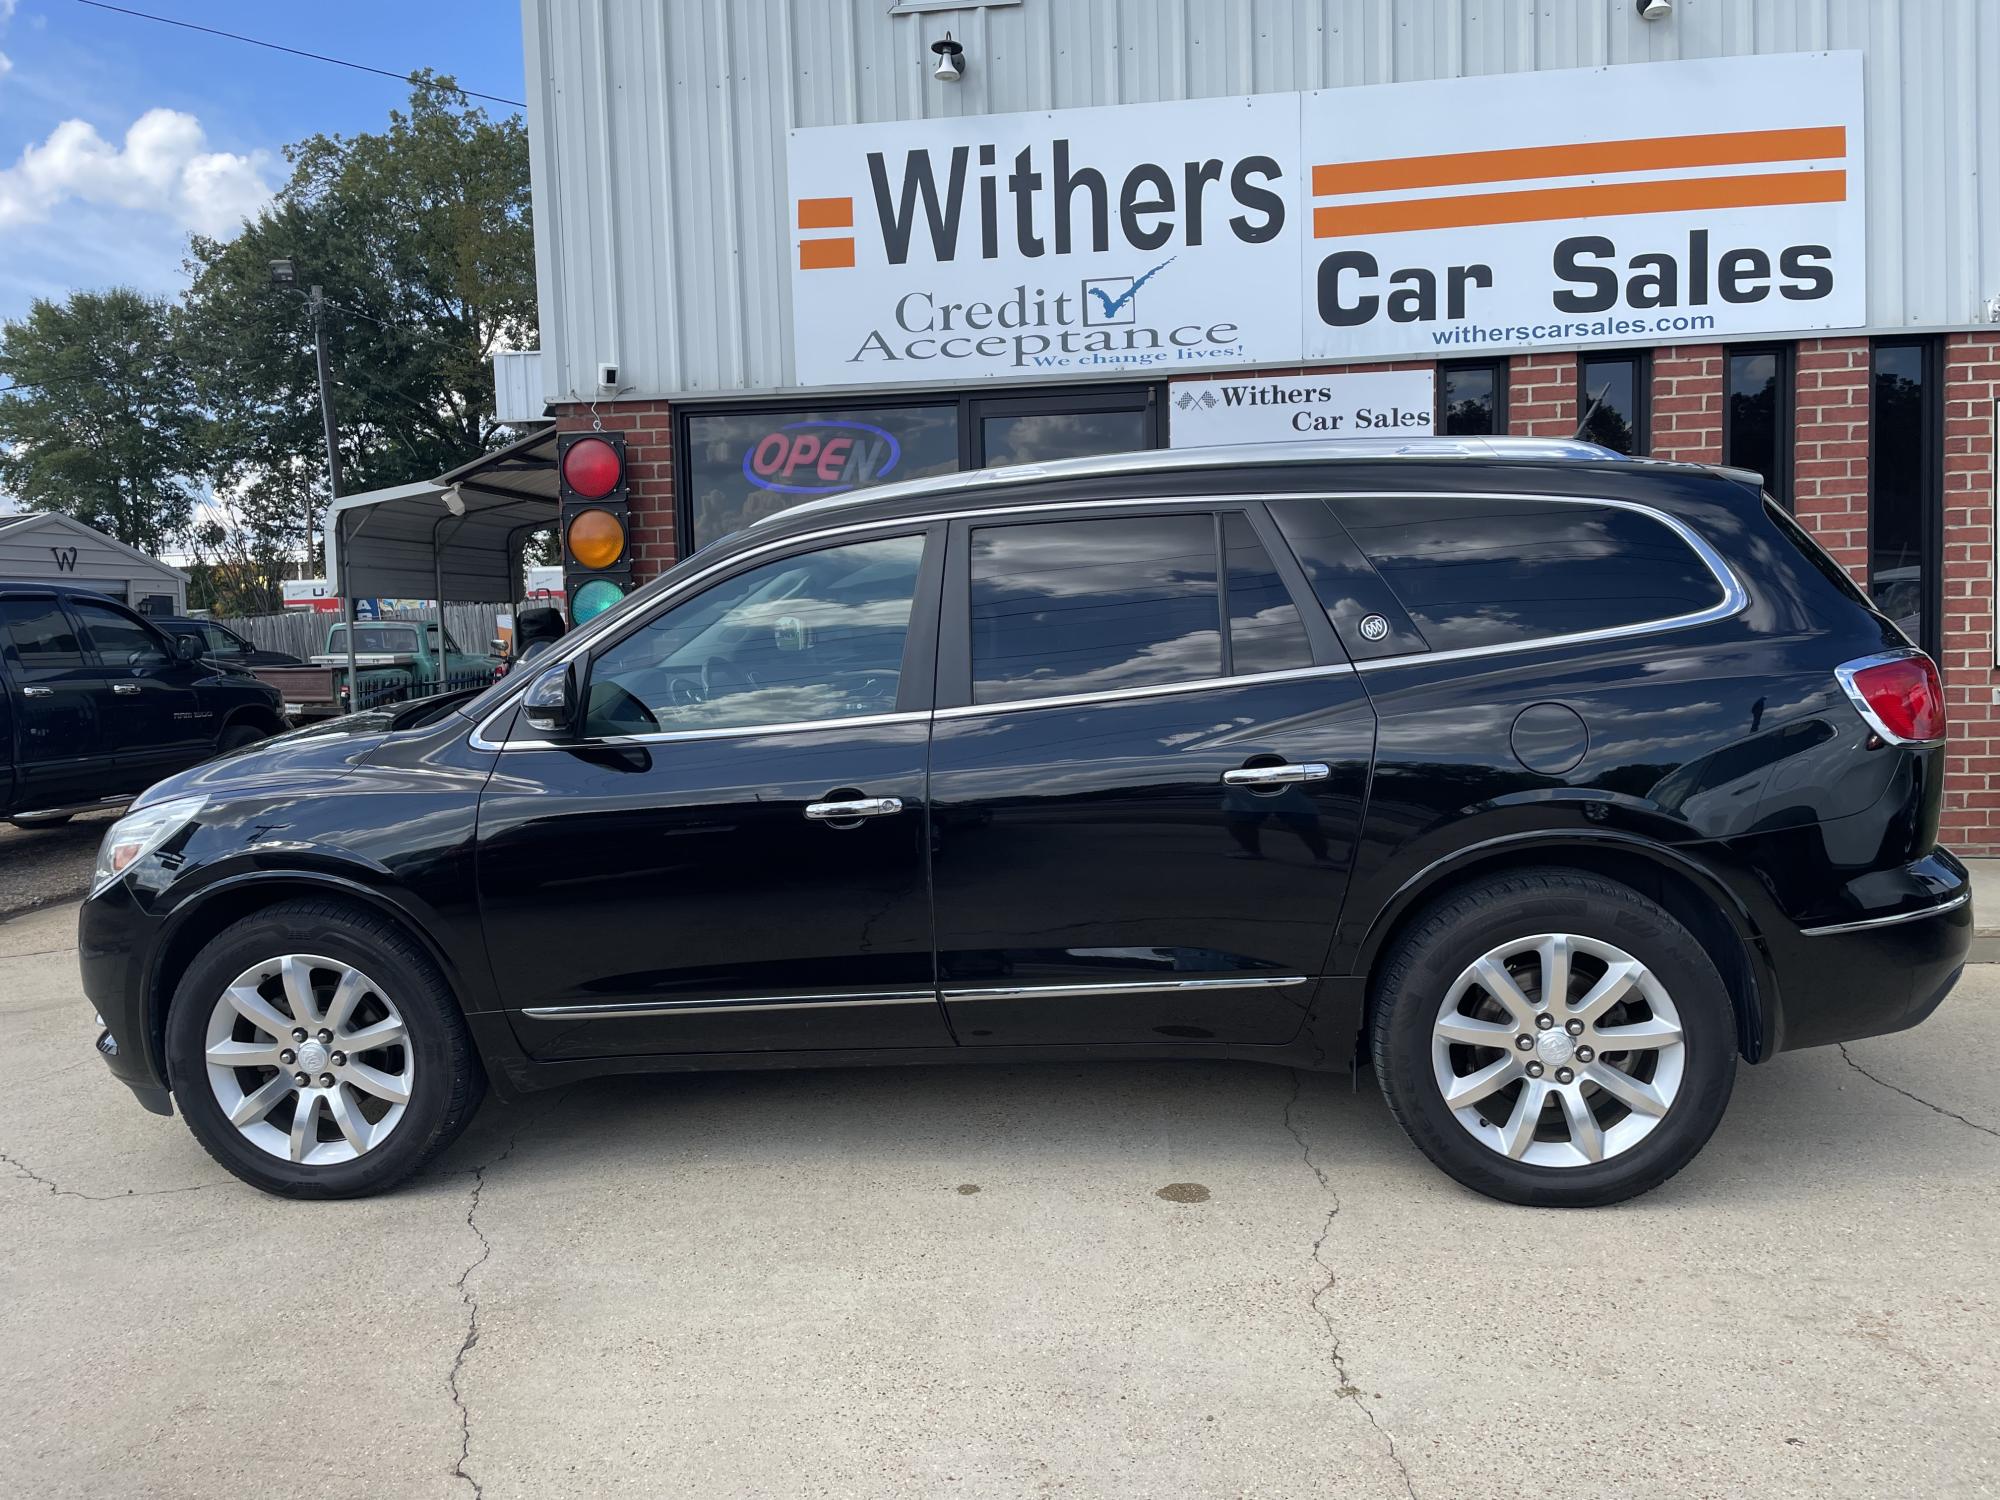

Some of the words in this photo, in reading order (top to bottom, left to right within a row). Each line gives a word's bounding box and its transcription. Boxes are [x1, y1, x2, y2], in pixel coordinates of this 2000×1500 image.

[866, 139, 1286, 265] Withers
[1317, 250, 1493, 327] Car
[1552, 229, 1834, 314] Sales
[895, 284, 1075, 333] Credit
[845, 323, 1239, 368] Acceptance
[1431, 315, 1715, 346] witherscarsales.com
[1032, 355, 1069, 367] We
[1079, 353, 1166, 365] change
[1177, 344, 1244, 360] lives!
[1220, 384, 1332, 407] Withers
[1291, 411, 1344, 432] Car
[1355, 407, 1431, 429] Sales
[753, 432, 884, 483] OPEN
[51, 546, 78, 572] W
